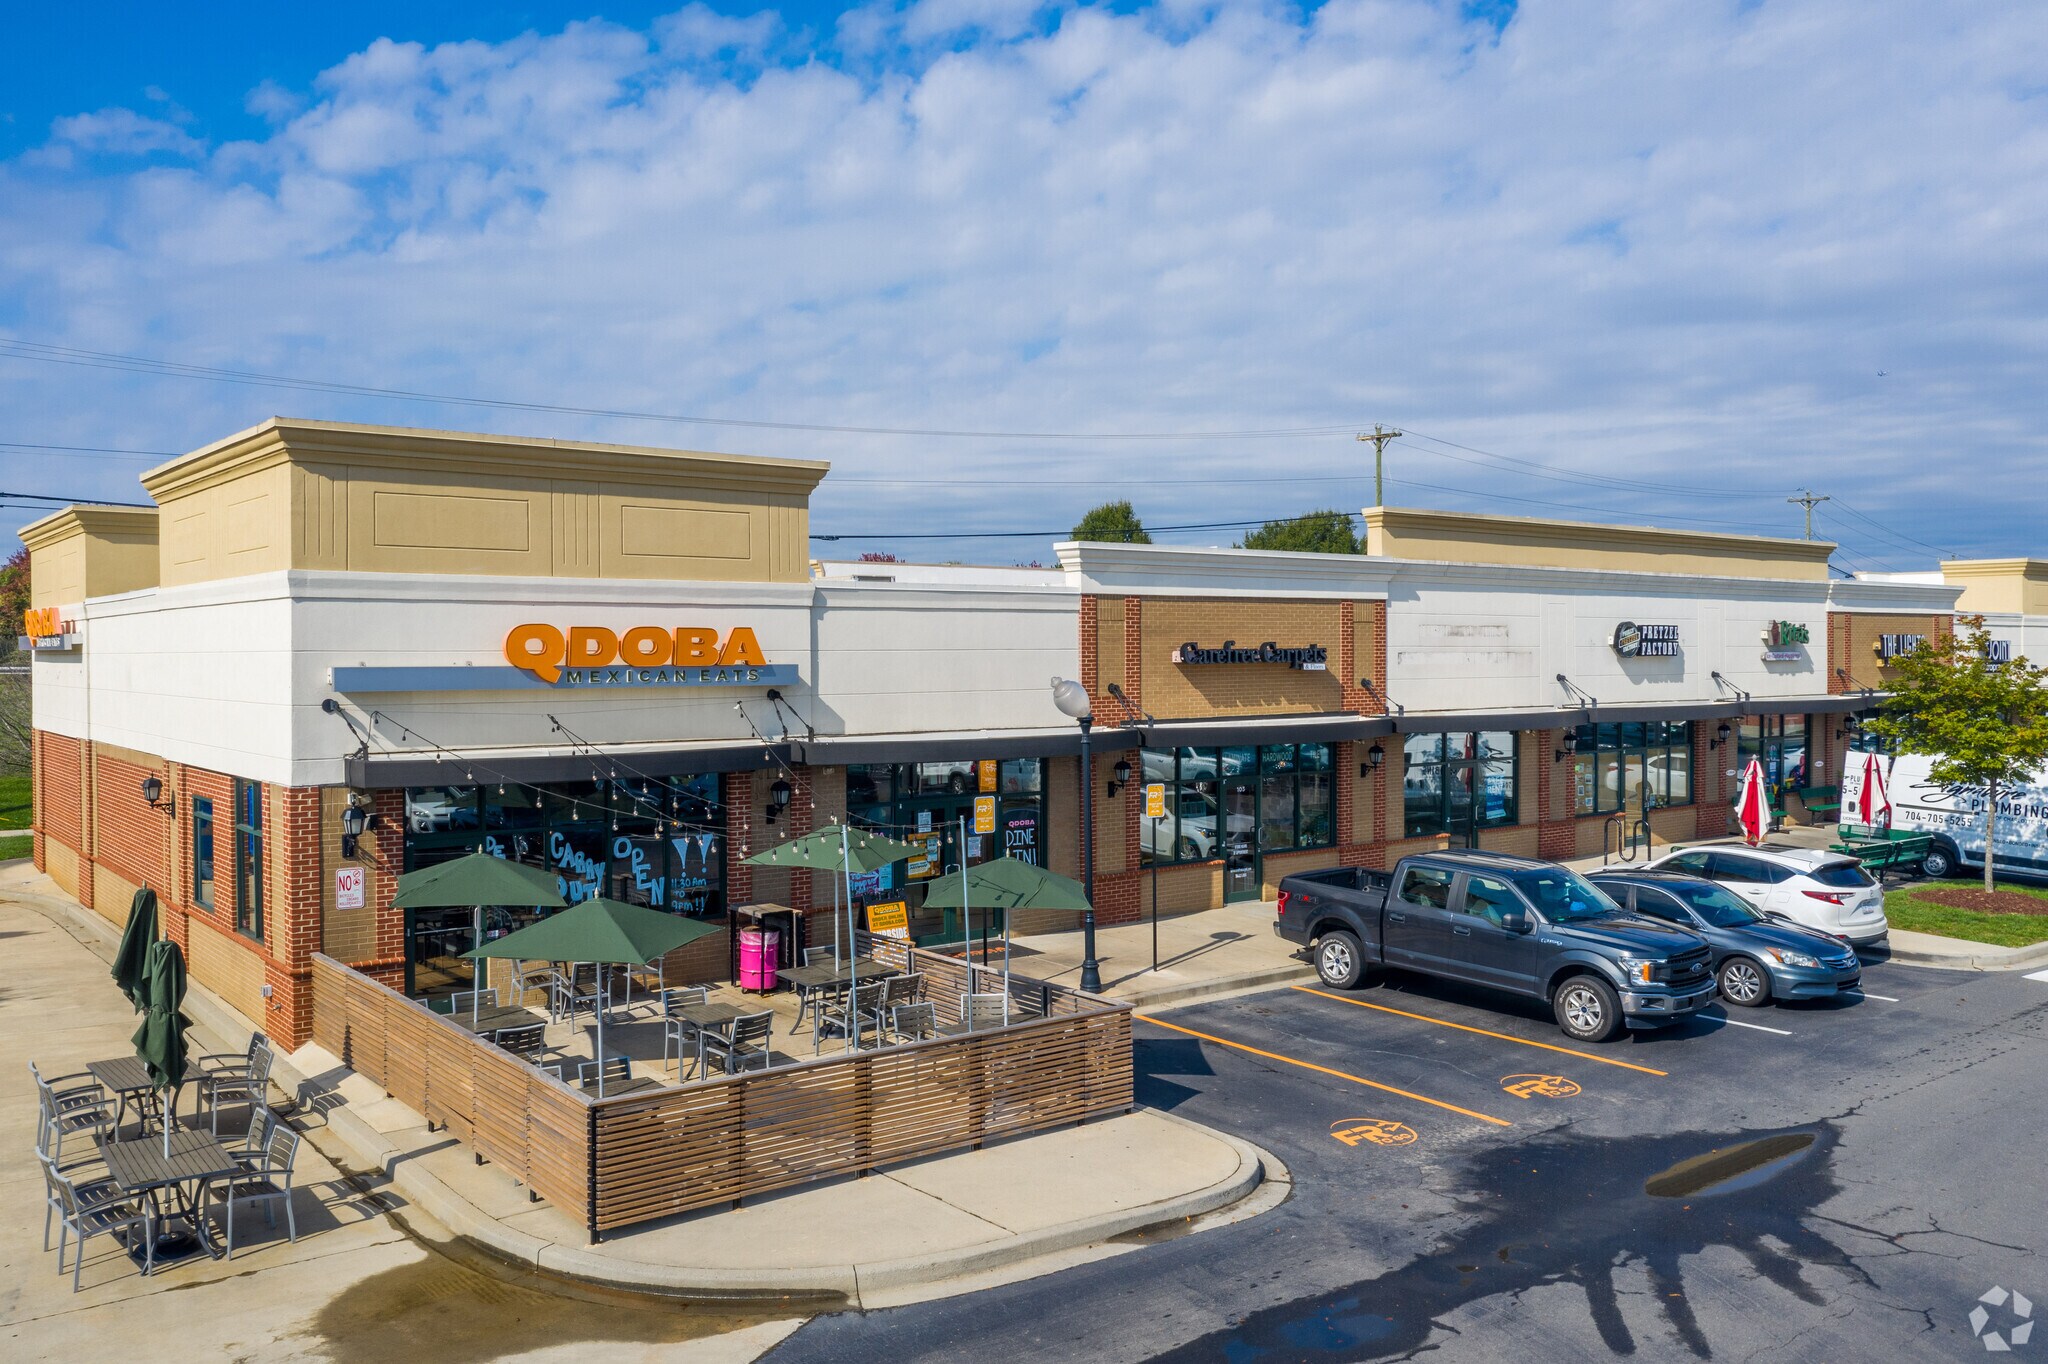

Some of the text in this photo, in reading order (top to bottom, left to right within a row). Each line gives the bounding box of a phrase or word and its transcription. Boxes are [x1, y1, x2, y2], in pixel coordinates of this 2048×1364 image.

[1642, 625, 1679, 639] PRETZEL
[503, 623, 767, 684] QDOBA
[1641, 641, 1679, 655] FACTORY
[1882, 634, 1897, 657] THE
[1180, 640, 1328, 670] Carefree Carpets
[566, 668, 760, 684] MEXICAN EATS
[1262, 752, 1292, 762] HARDWOOD
[1008, 819, 1036, 828] QDOBA
[1905, 811, 1972, 827] 704-705-5255
[1005, 828, 1036, 847] DINE
[550, 832, 606, 892] CARRY
[613, 837, 666, 905] OPEN
[338, 875, 352, 892] NO
